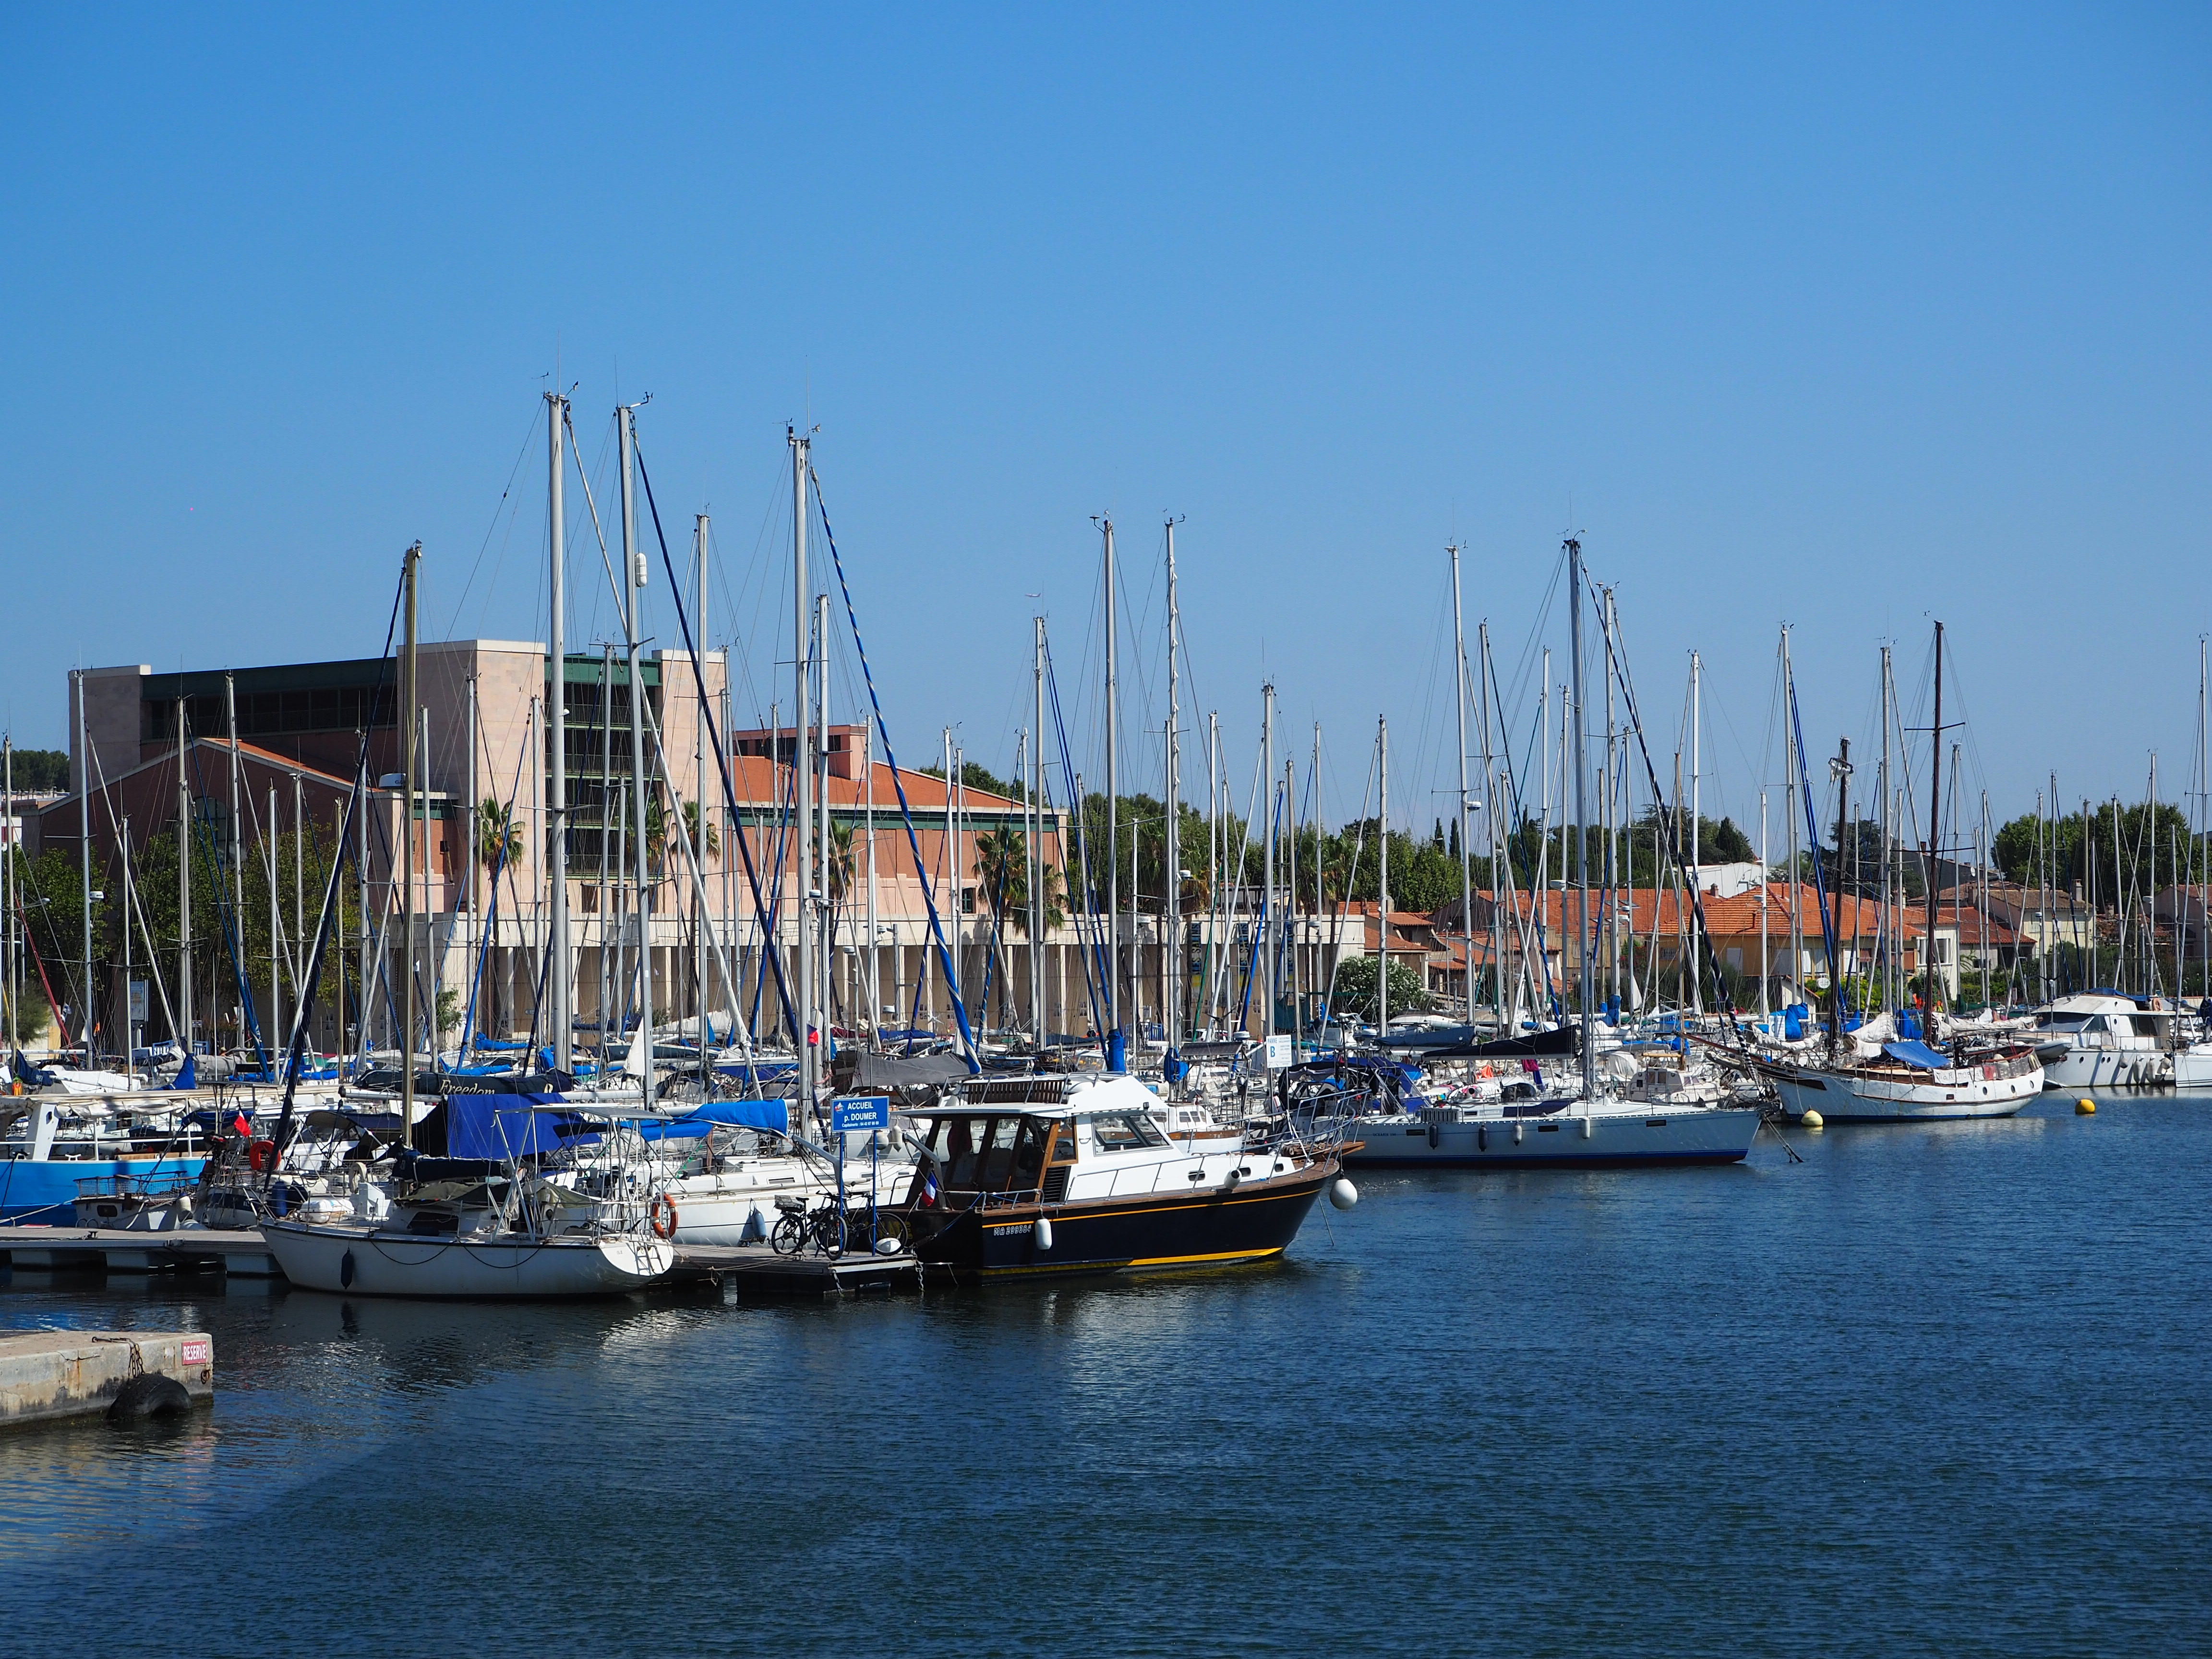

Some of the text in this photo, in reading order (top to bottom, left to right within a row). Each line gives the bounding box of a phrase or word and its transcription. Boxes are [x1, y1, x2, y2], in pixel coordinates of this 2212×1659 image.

[1270, 1046, 1275, 1058] B
[438, 1079, 495, 1095] Freedom
[847, 1101, 874, 1110] ACCUEIL
[851, 1112, 877, 1121] DOUMER
[994, 1227, 1005, 1236] MA
[183, 1344, 206, 1360] RESERVE
